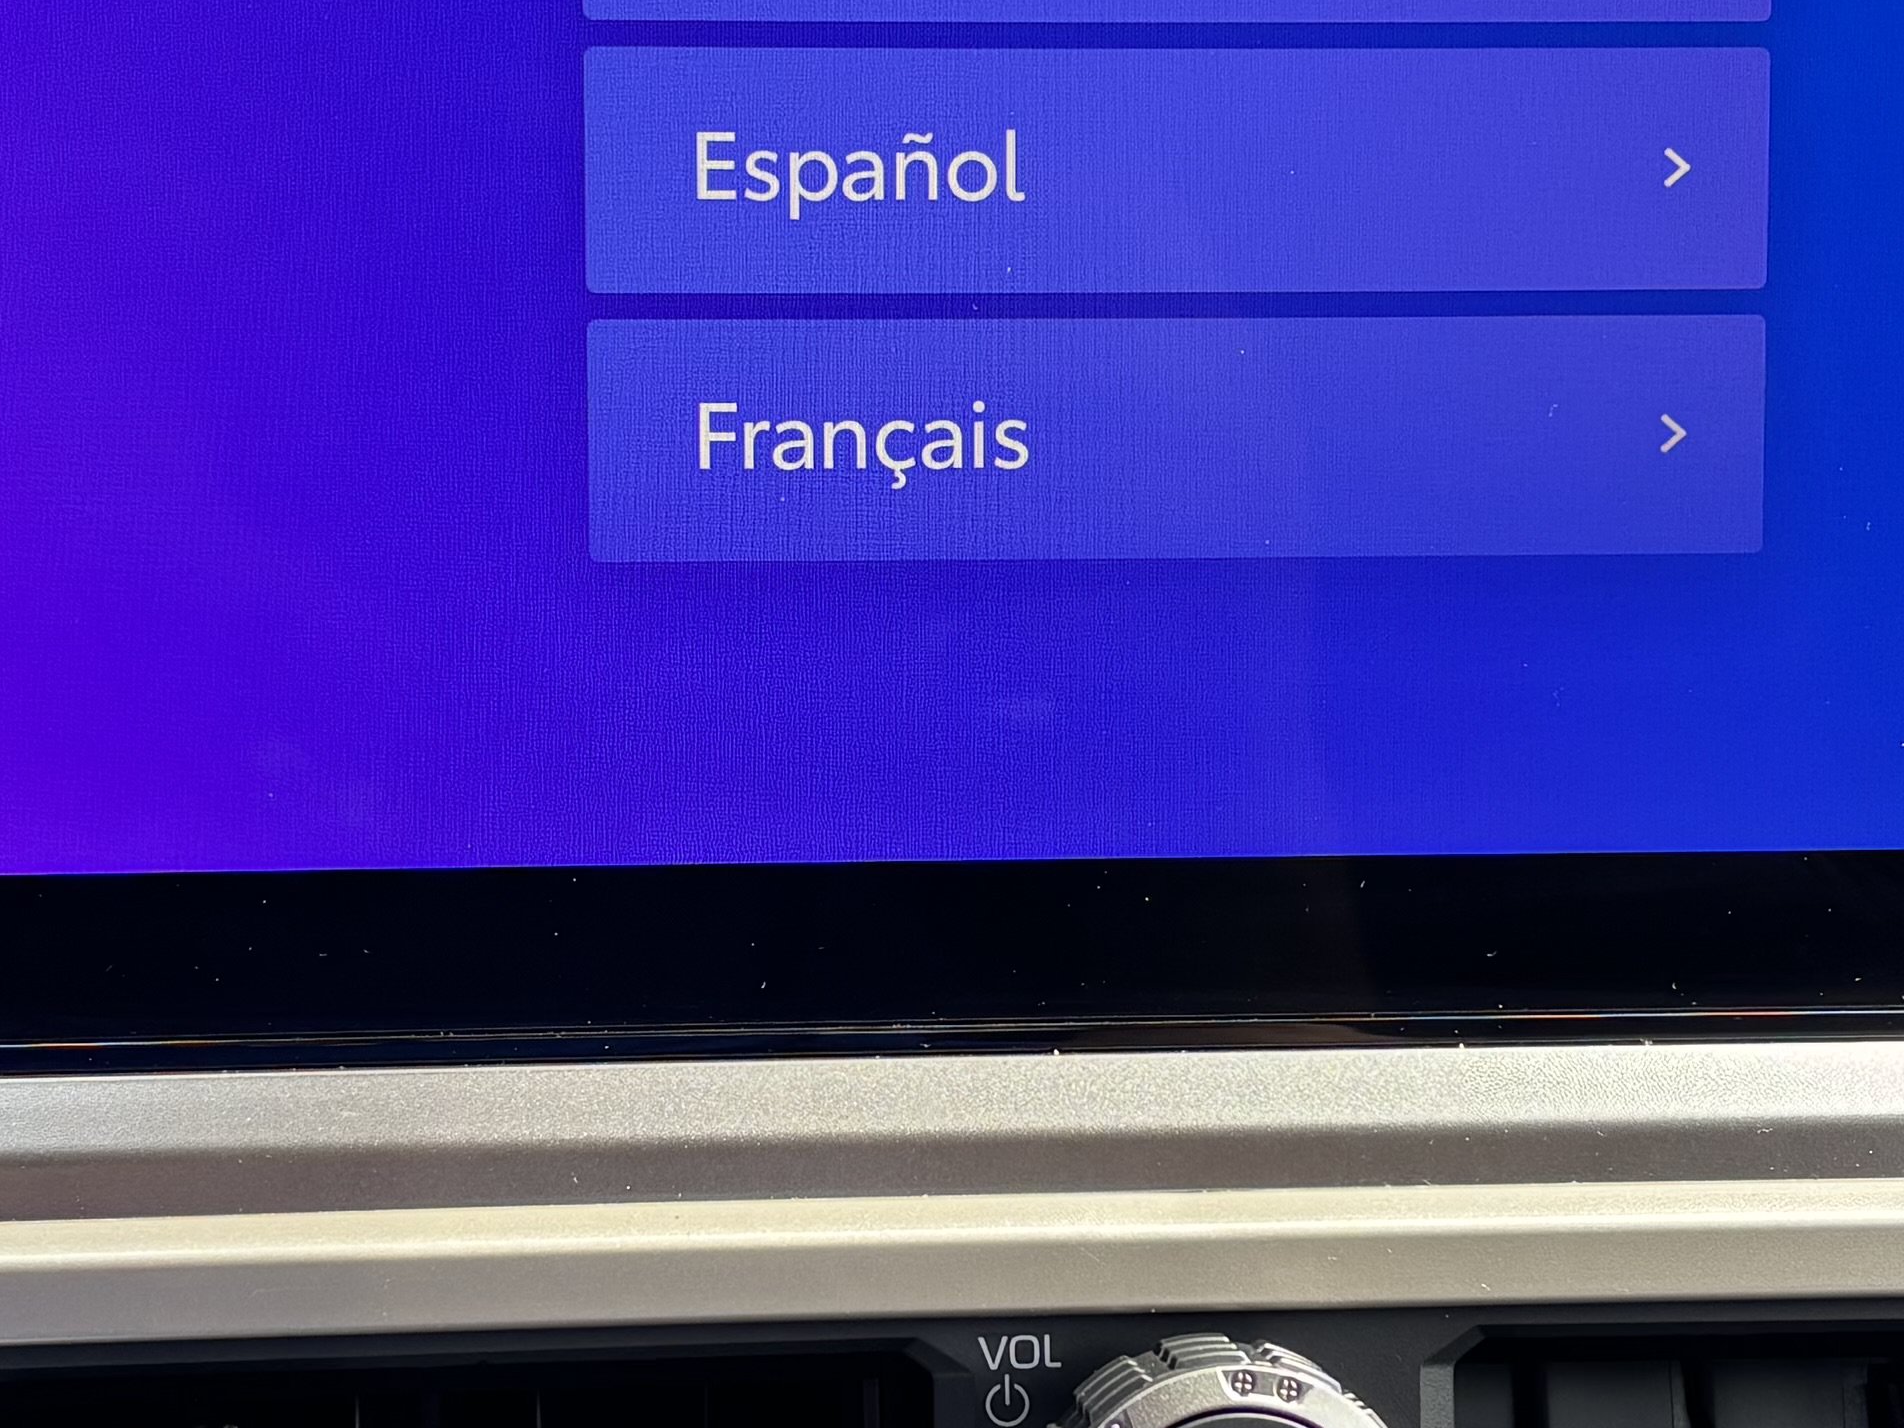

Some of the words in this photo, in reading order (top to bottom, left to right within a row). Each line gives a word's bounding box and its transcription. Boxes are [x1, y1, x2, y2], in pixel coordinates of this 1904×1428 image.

[695, 129, 1026, 220] Español
[698, 400, 1030, 490] Français
[978, 1333, 1062, 1371] VOL
